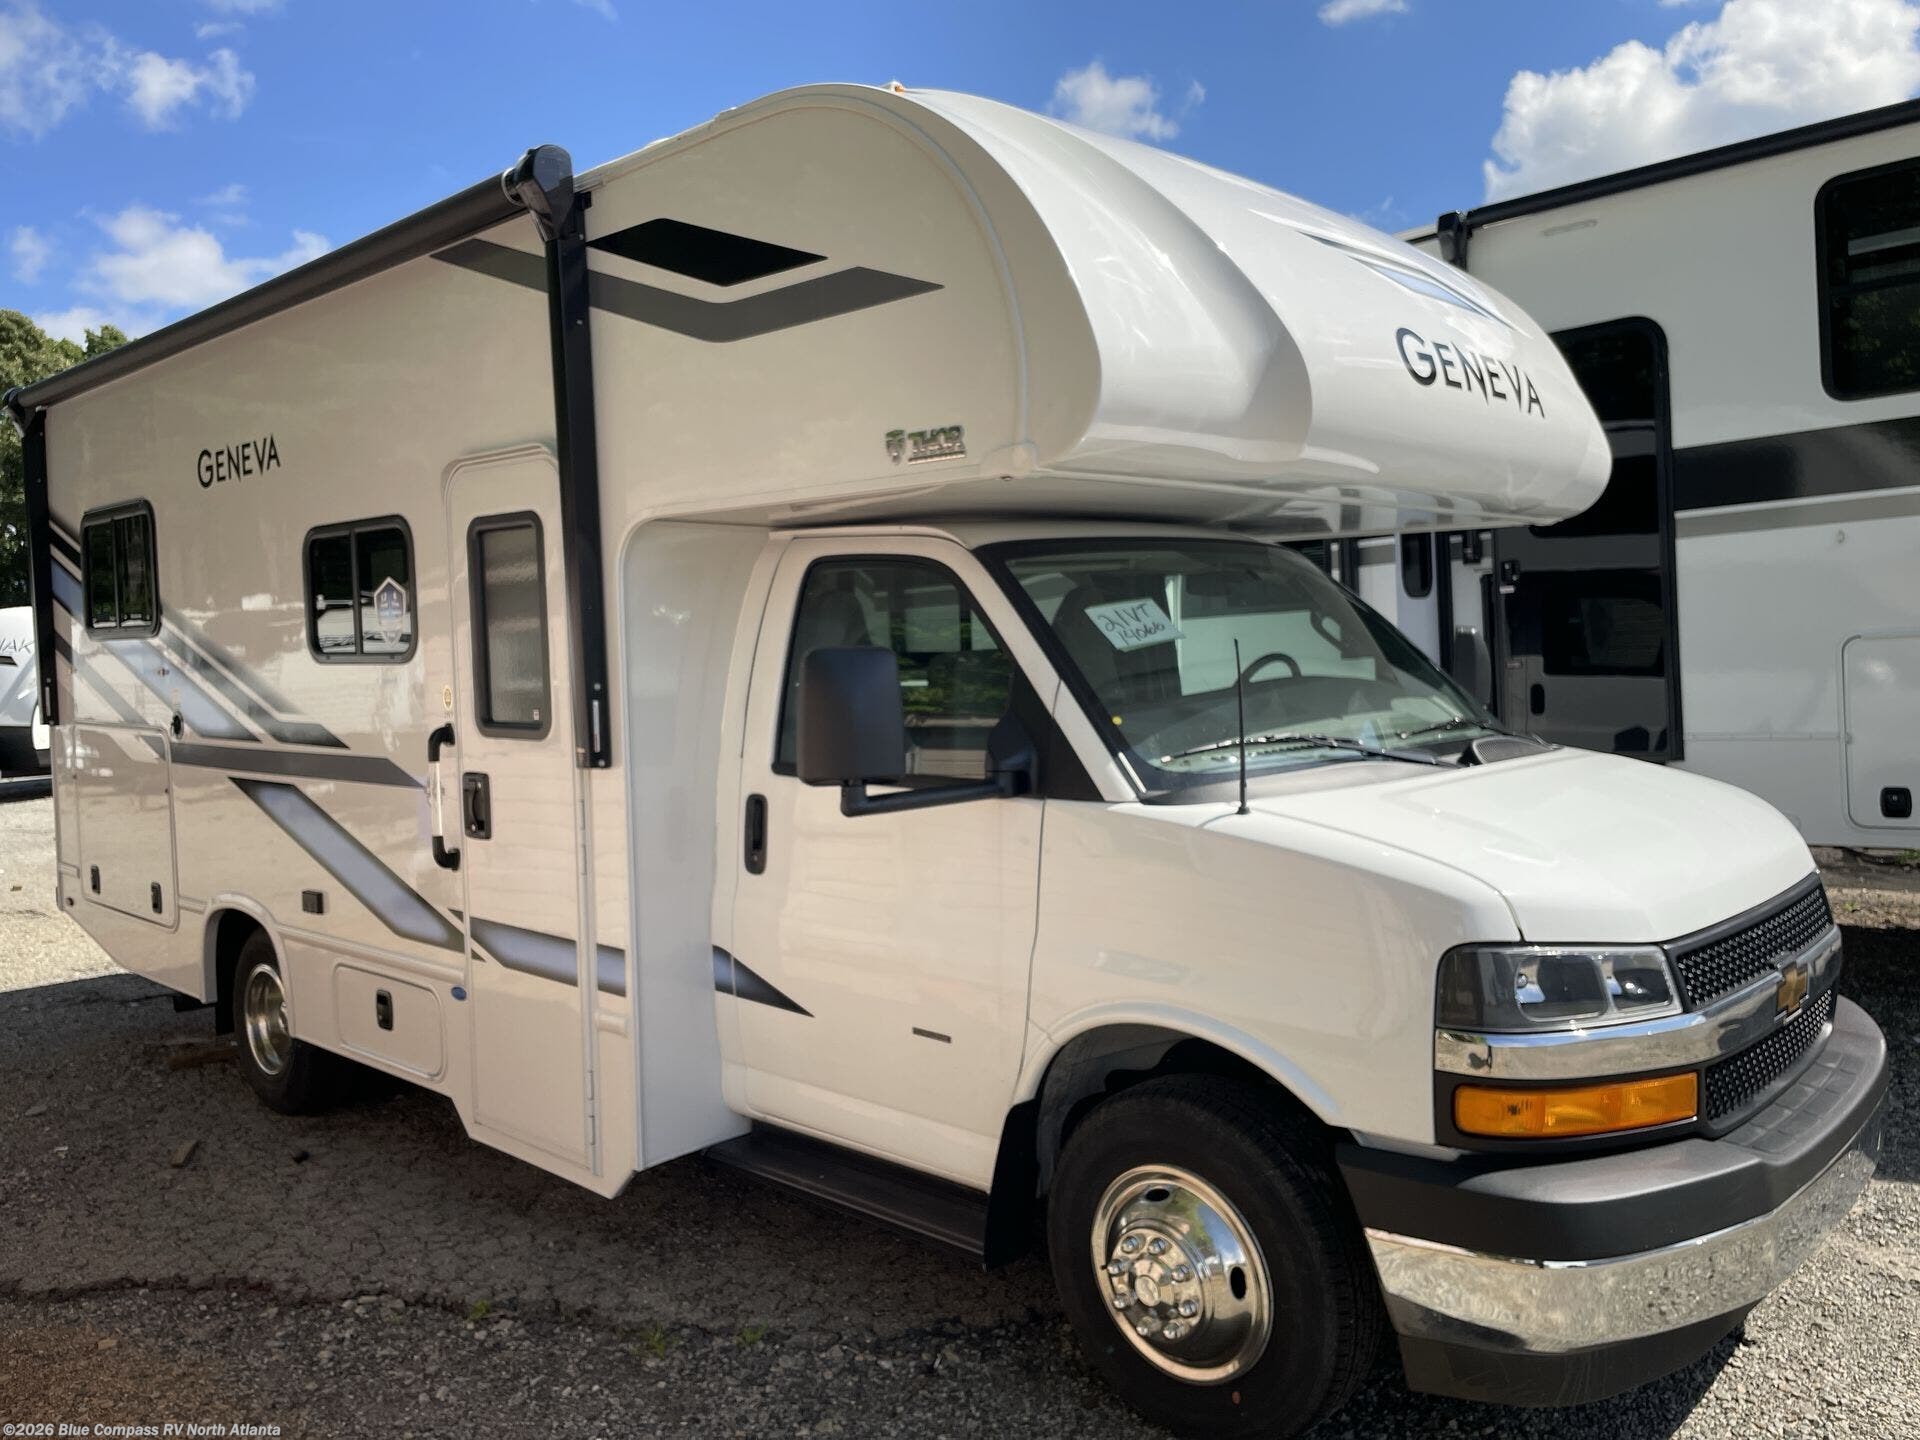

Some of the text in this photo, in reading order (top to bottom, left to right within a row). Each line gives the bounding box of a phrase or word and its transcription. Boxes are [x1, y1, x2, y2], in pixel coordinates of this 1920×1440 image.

[1395, 327, 1545, 419] GENEVA
[197, 434, 281, 489] GENEVA
[907, 424, 964, 456] THOR
